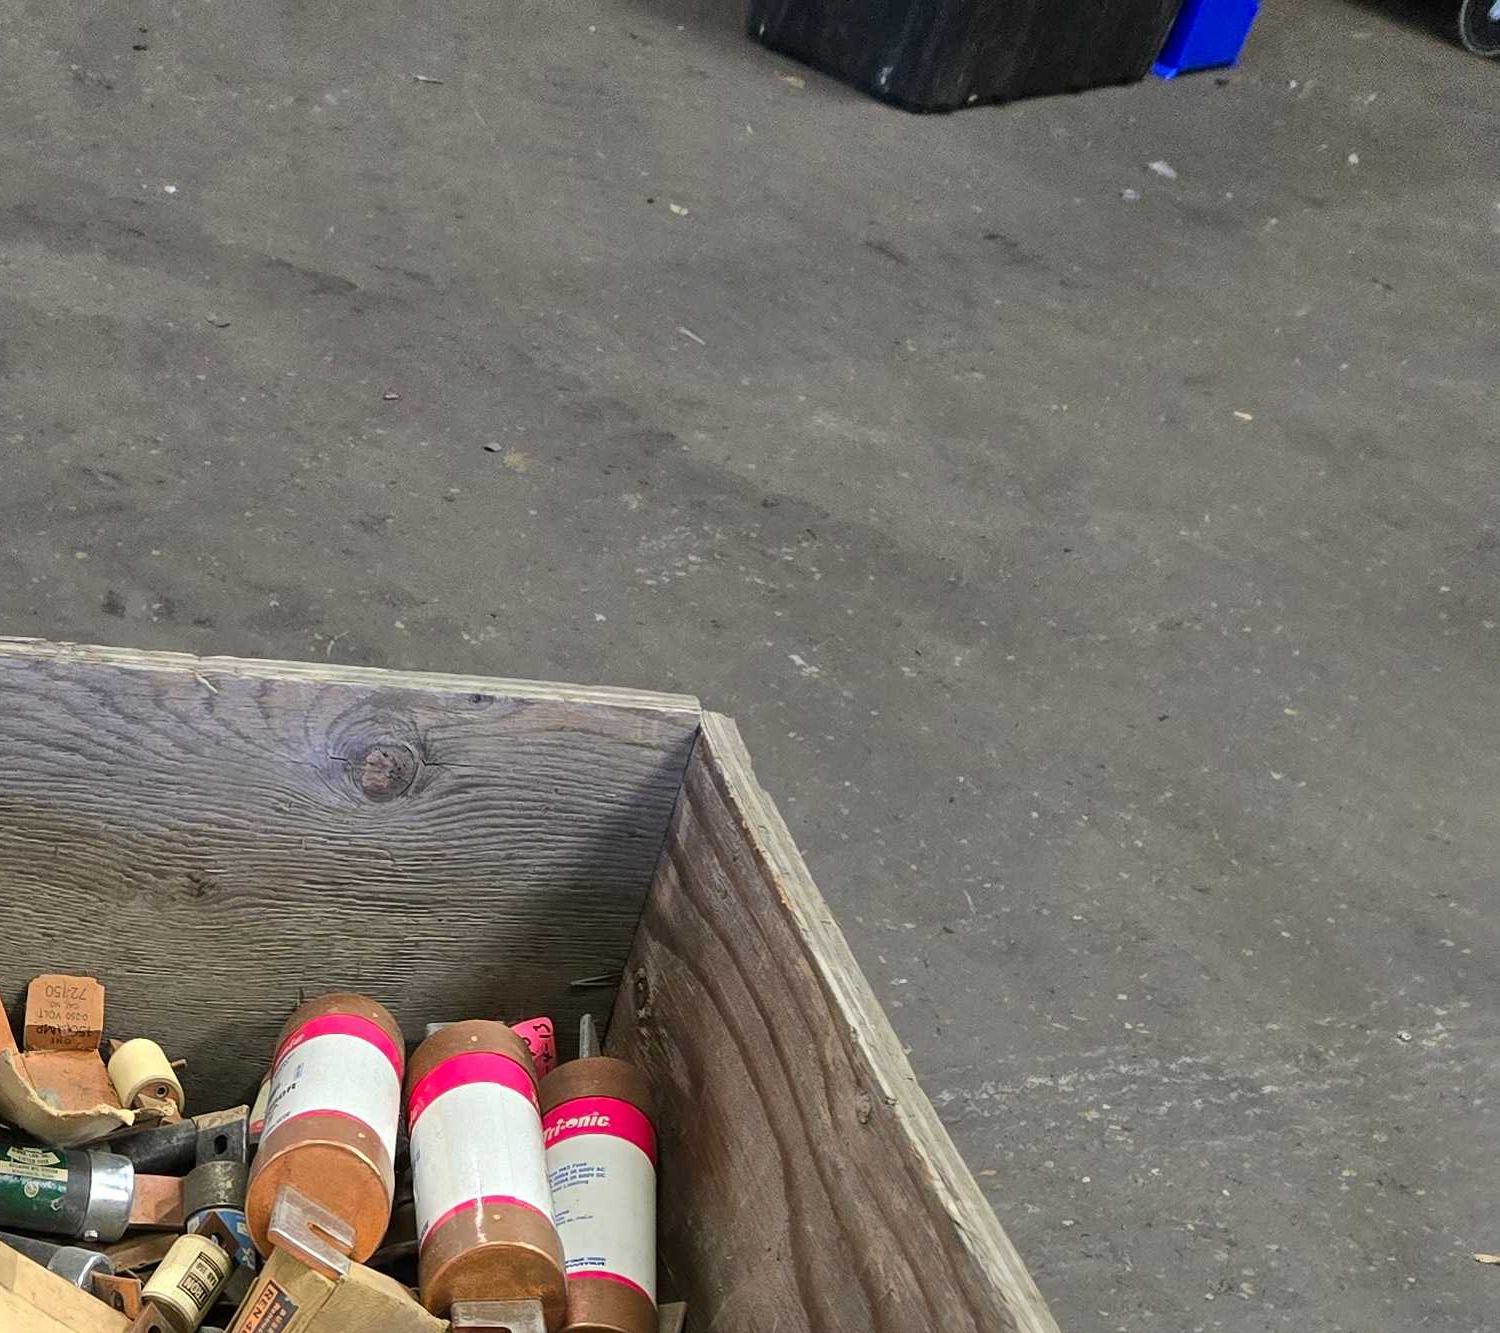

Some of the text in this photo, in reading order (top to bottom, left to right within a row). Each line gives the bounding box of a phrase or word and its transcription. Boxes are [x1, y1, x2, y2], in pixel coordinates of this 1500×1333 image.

[45, 984, 87, 1001] 72-150
[37, 1008, 62, 1020] VOLT
[182, 1276, 207, 1302] TRON
[253, 1285, 275, 1319] REN
